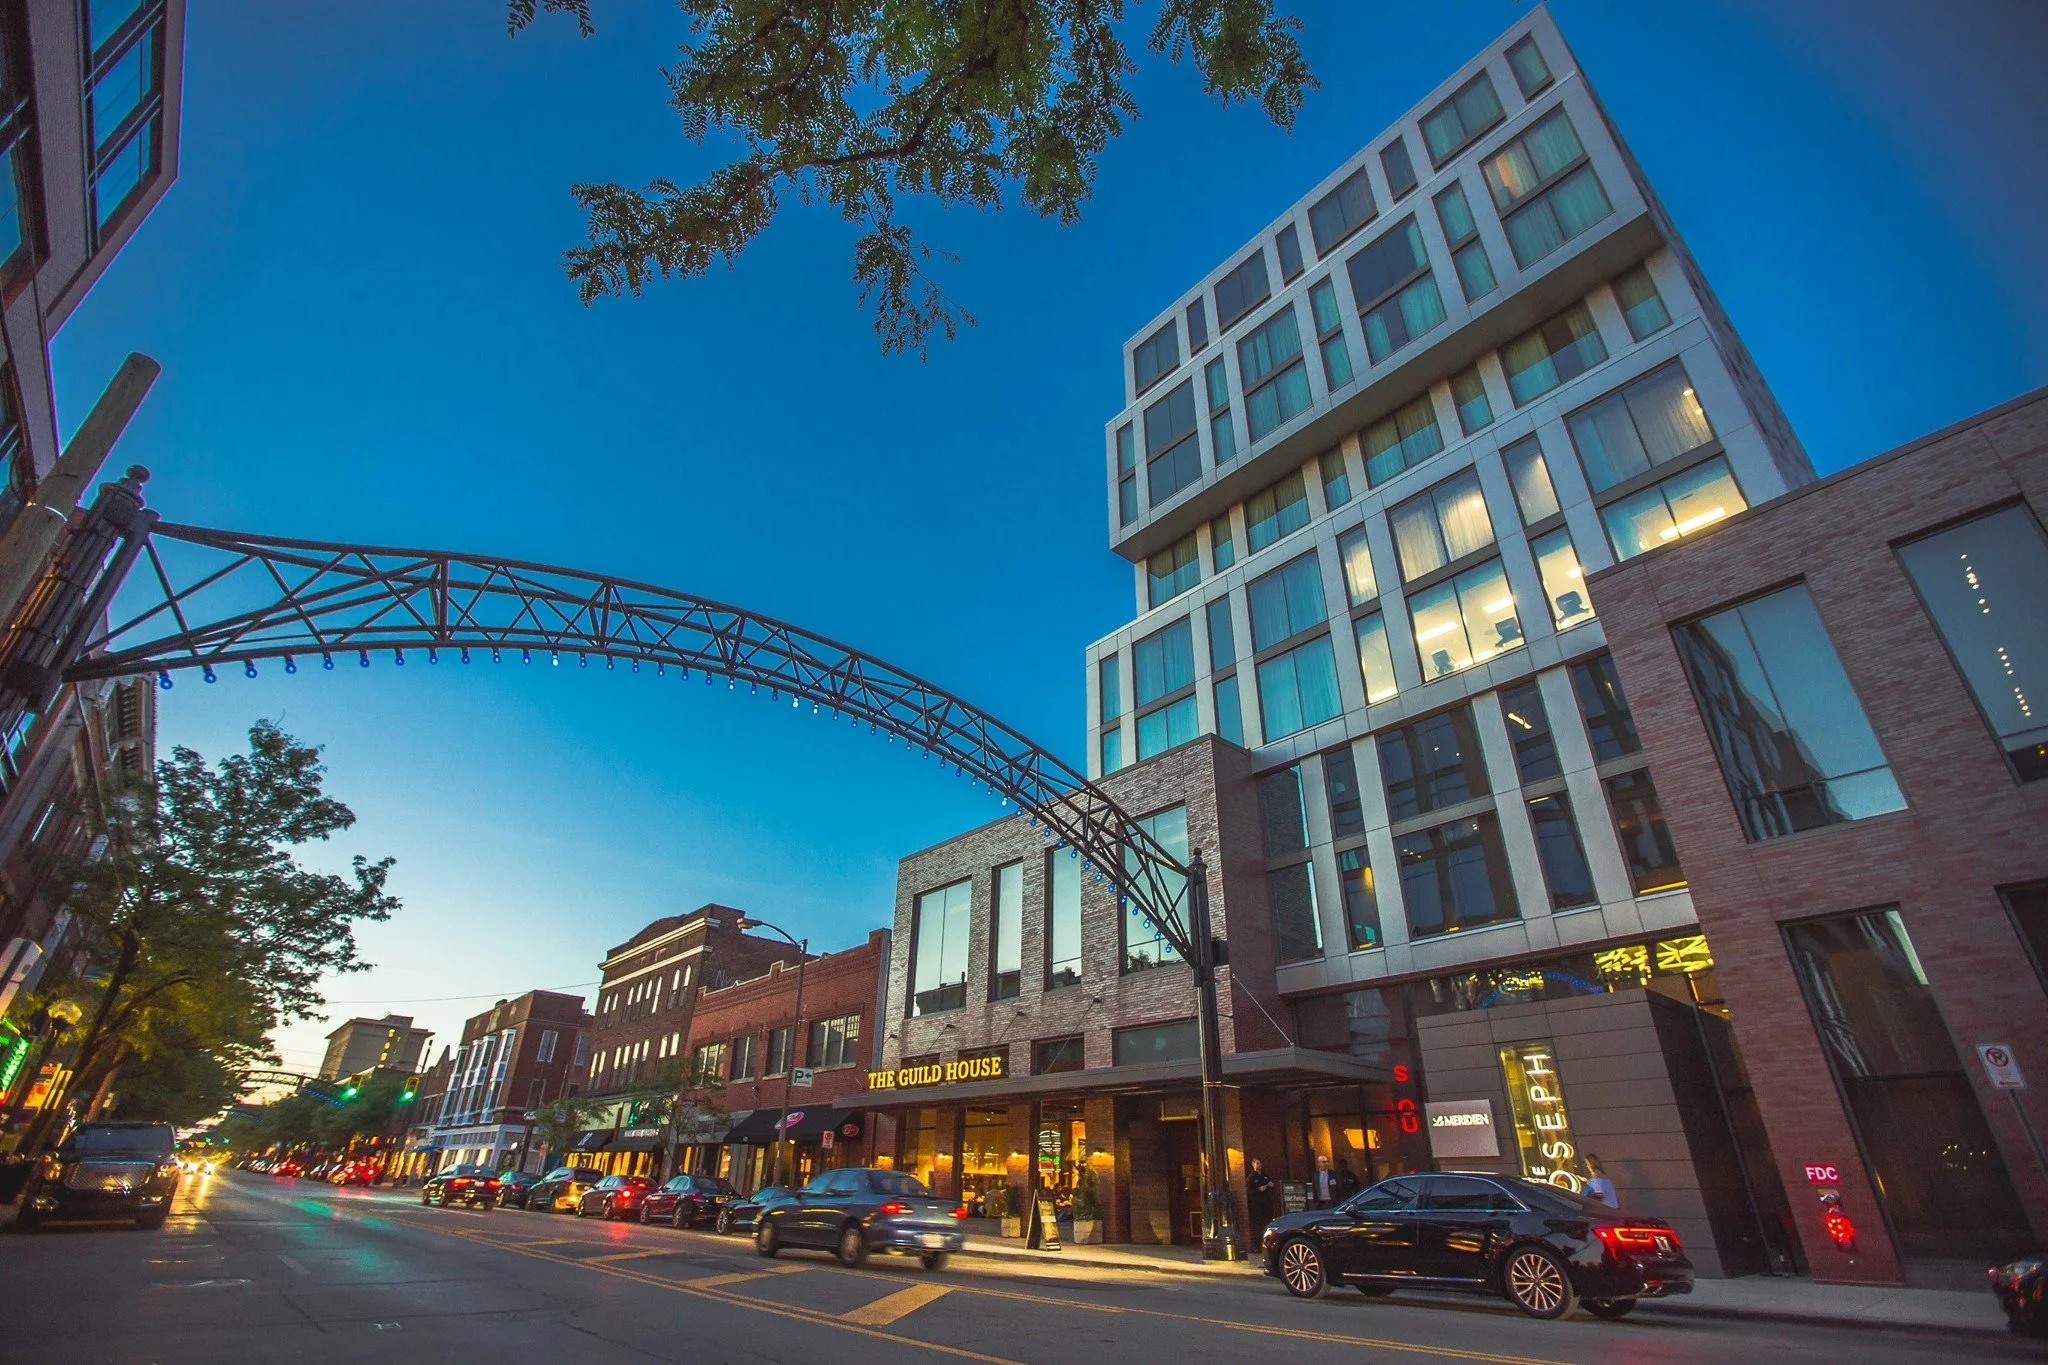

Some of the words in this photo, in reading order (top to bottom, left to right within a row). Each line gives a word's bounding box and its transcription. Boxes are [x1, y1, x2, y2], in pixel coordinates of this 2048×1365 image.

[868, 1070, 896, 1090] THE
[898, 1064, 942, 1087] GUILD
[945, 1056, 1002, 1081] HOUSE
[1523, 1054, 1581, 1194] OSEPH
[1805, 1166, 1838, 1180] FDC
